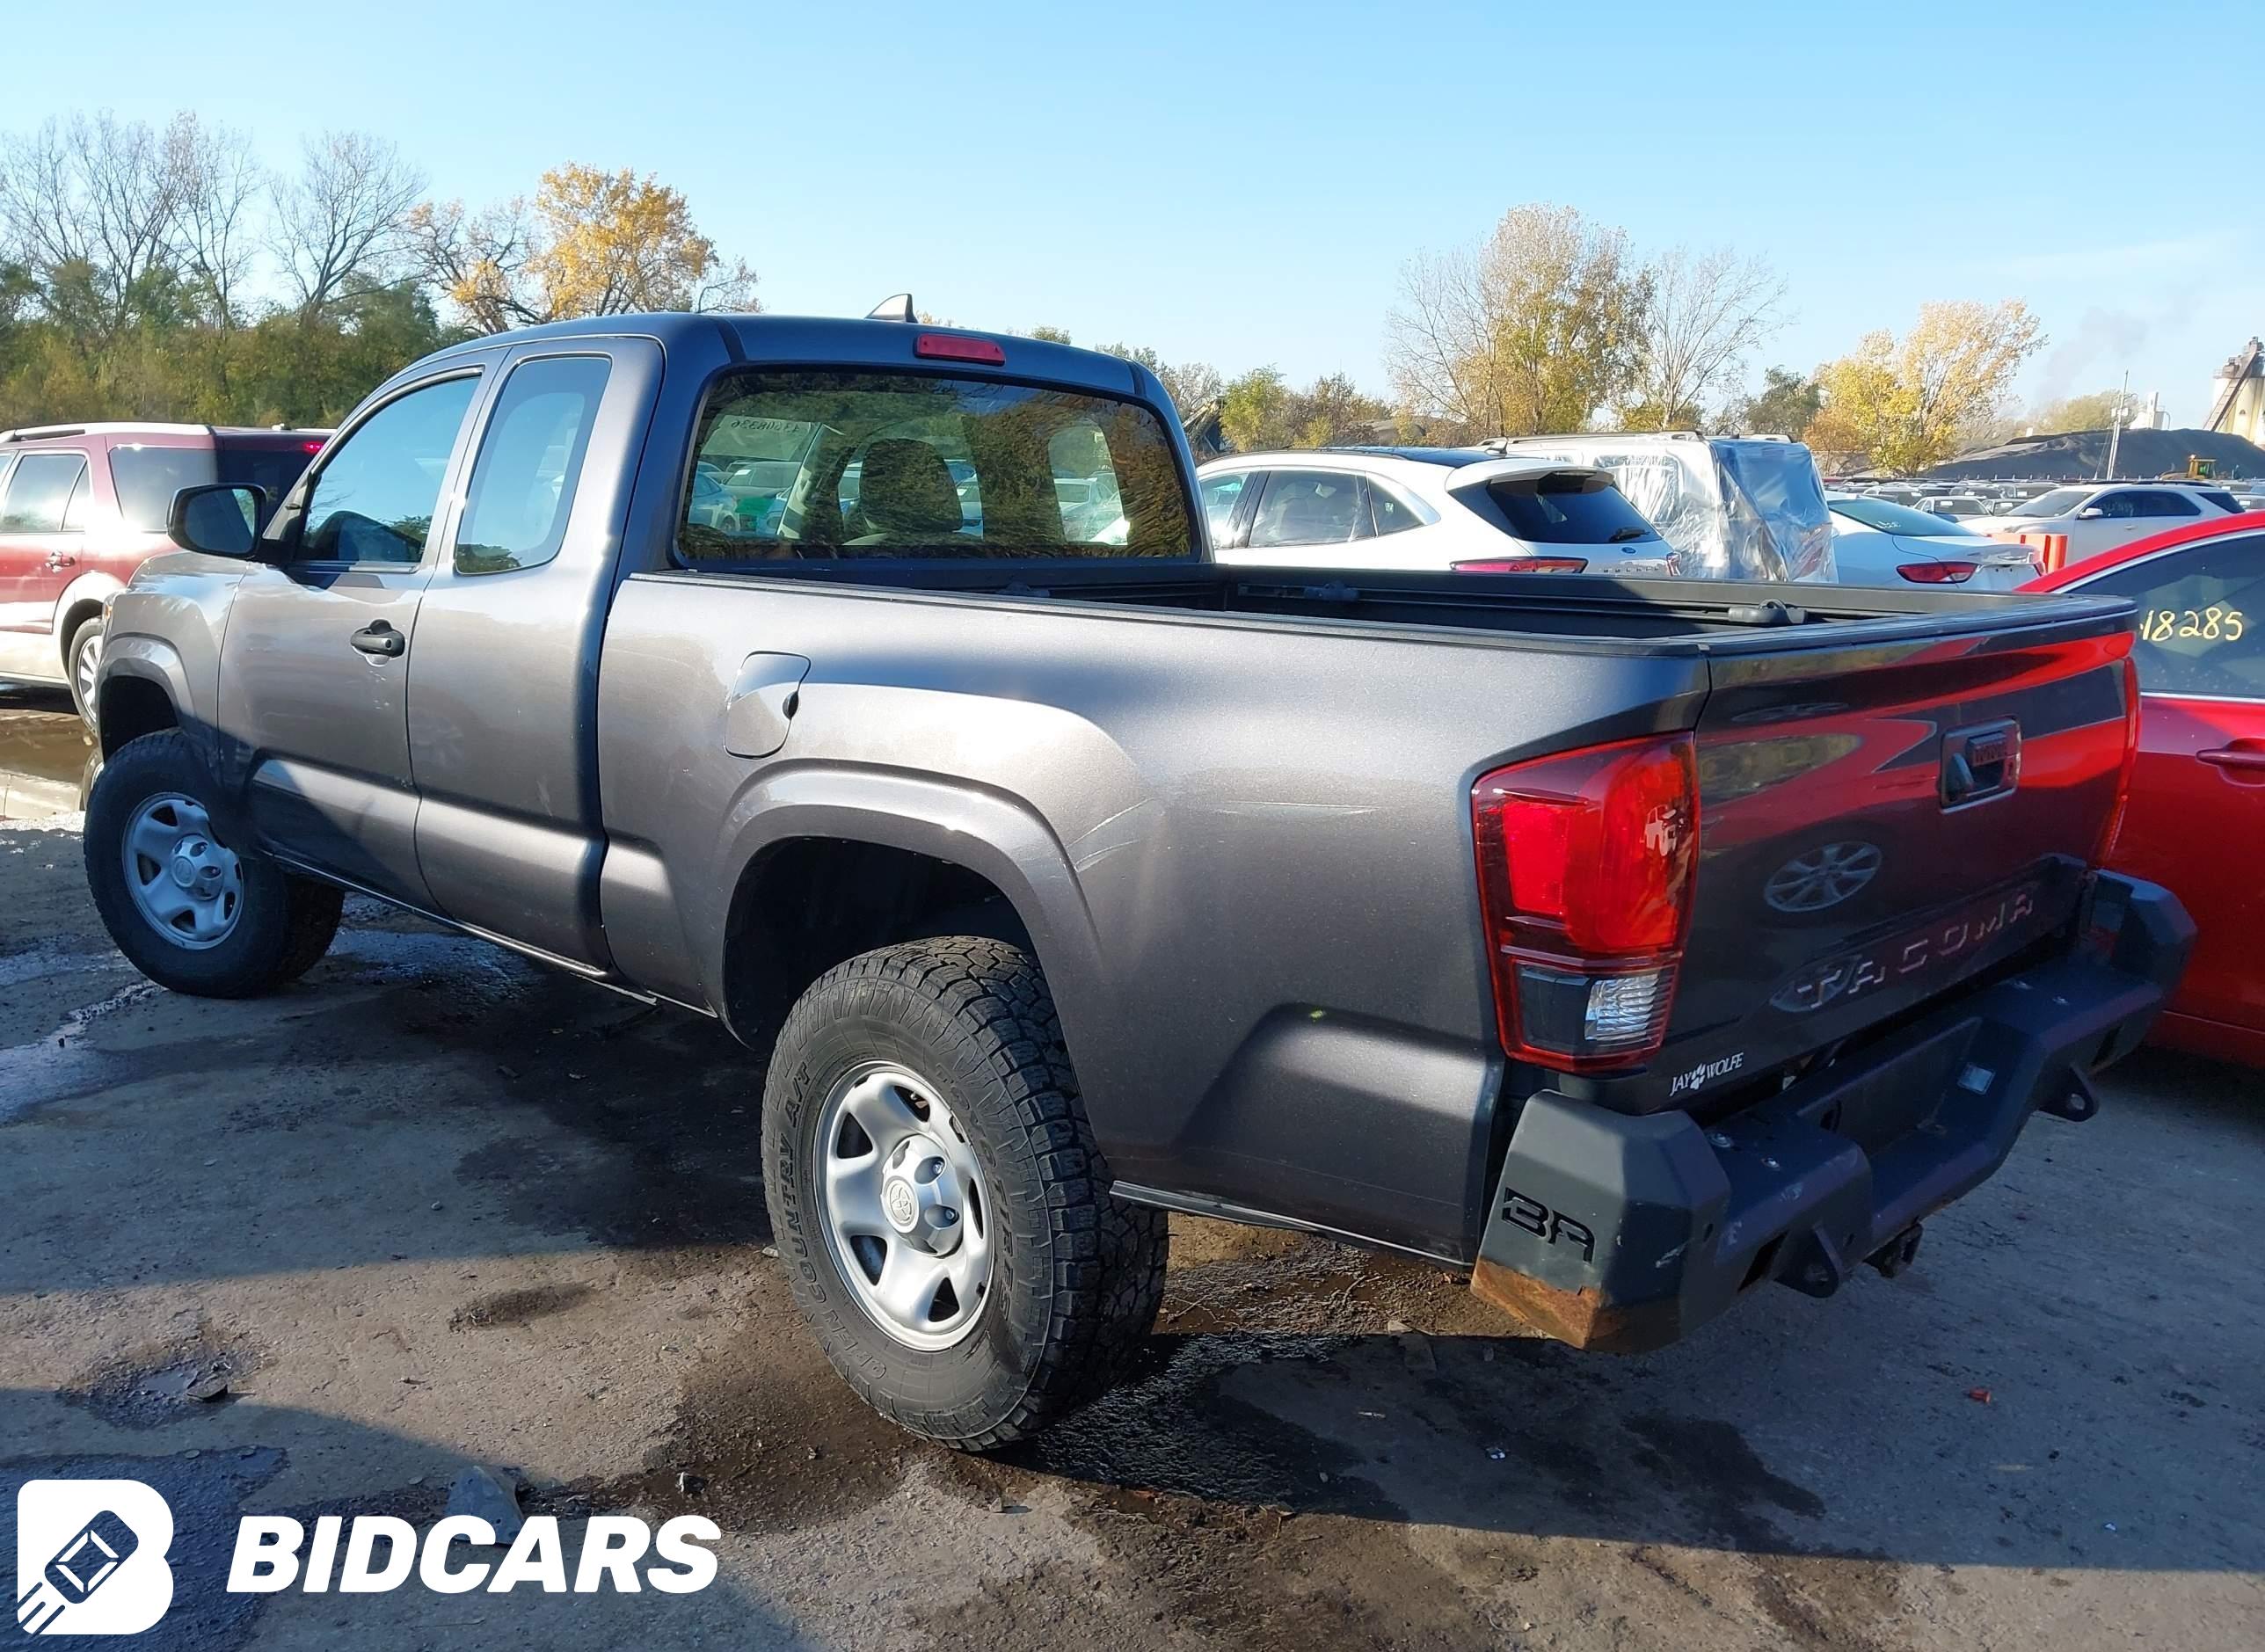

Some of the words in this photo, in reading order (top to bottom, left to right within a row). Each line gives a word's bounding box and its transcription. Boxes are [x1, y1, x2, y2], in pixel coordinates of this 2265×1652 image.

[2138, 607, 2244, 642] 18285
[1796, 893, 2034, 1009] TACOMA
[783, 1061, 812, 1129] A/T
[1669, 1072, 1693, 1097] JAY
[1706, 1052, 1744, 1080] WOLFE
[778, 1132, 827, 1305] COUNTRY
[993, 1176, 1013, 1321] TIRES
[821, 1308, 887, 1379] OPEN
